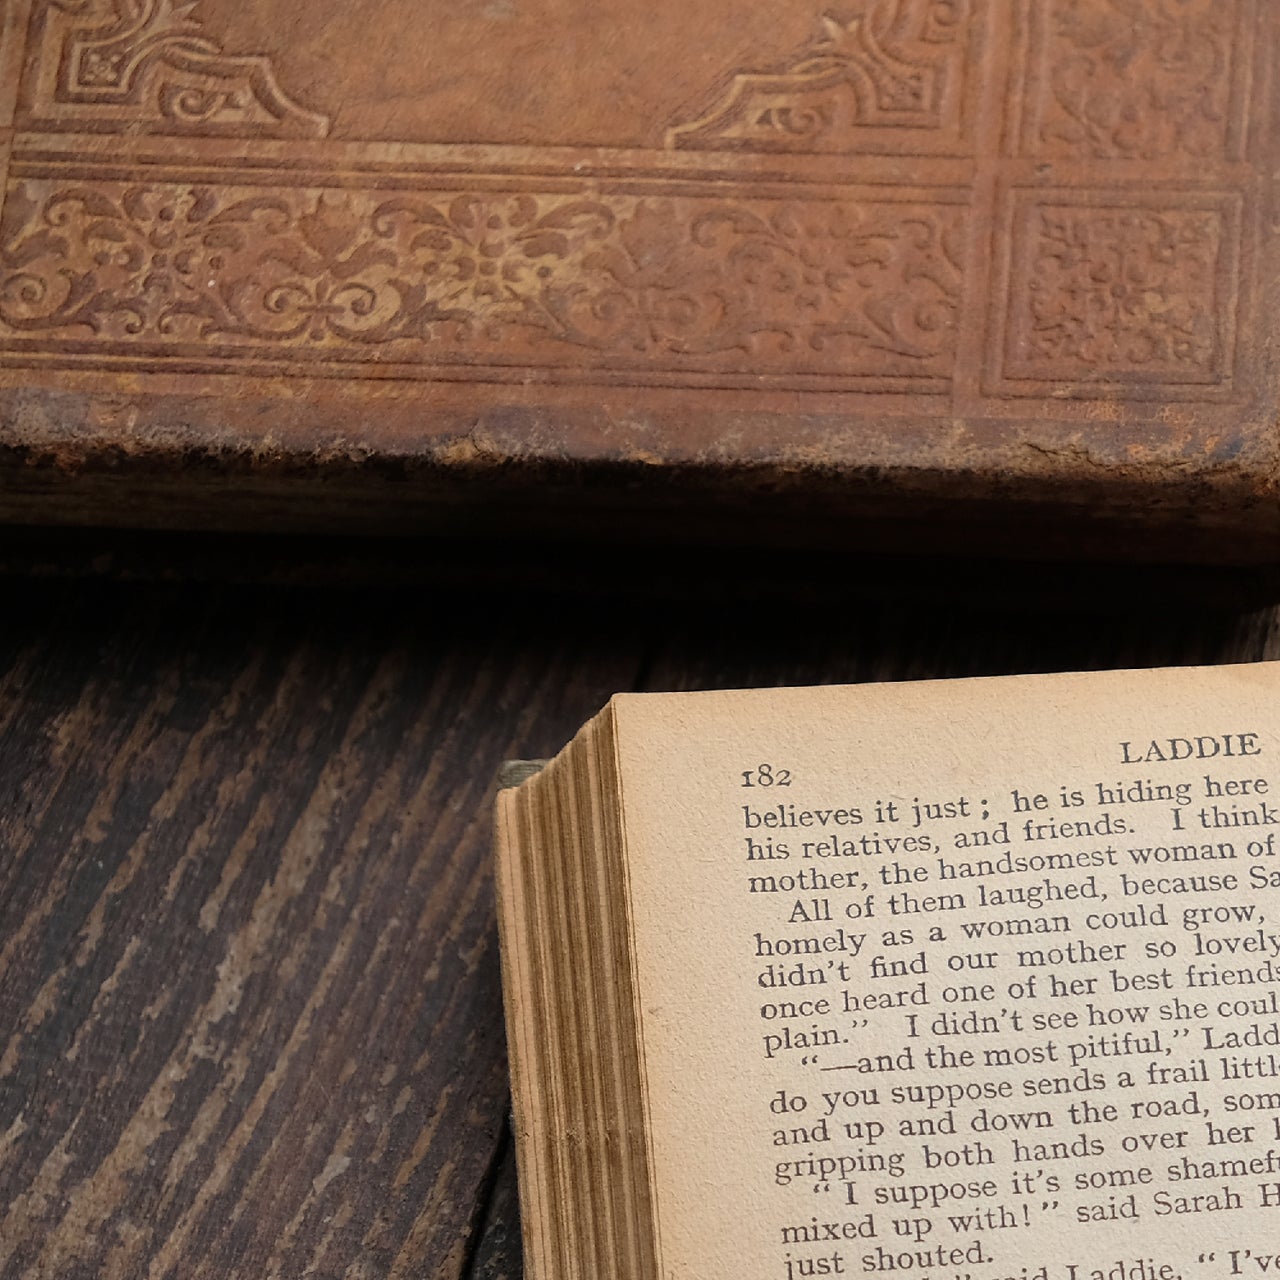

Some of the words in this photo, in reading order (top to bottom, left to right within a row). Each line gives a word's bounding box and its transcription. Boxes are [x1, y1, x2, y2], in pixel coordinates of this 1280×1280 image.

[1118, 731, 1263, 766] LADDIE
[739, 762, 793, 789] 182
[743, 835, 791, 862] his
[800, 833, 941, 860] relatives,
[952, 820, 1013, 850] and
[1021, 811, 1137, 843] friends.
[1168, 806, 1187, 832] I
[768, 1089, 809, 1116] do
[820, 1087, 882, 1118] you
[889, 1080, 1014, 1111] suppose
[1021, 1066, 1108, 1098] sends
[1115, 1070, 1137, 1090] a
[1145, 1057, 1212, 1087] frail
[860, 1238, 995, 1274] shouted.
